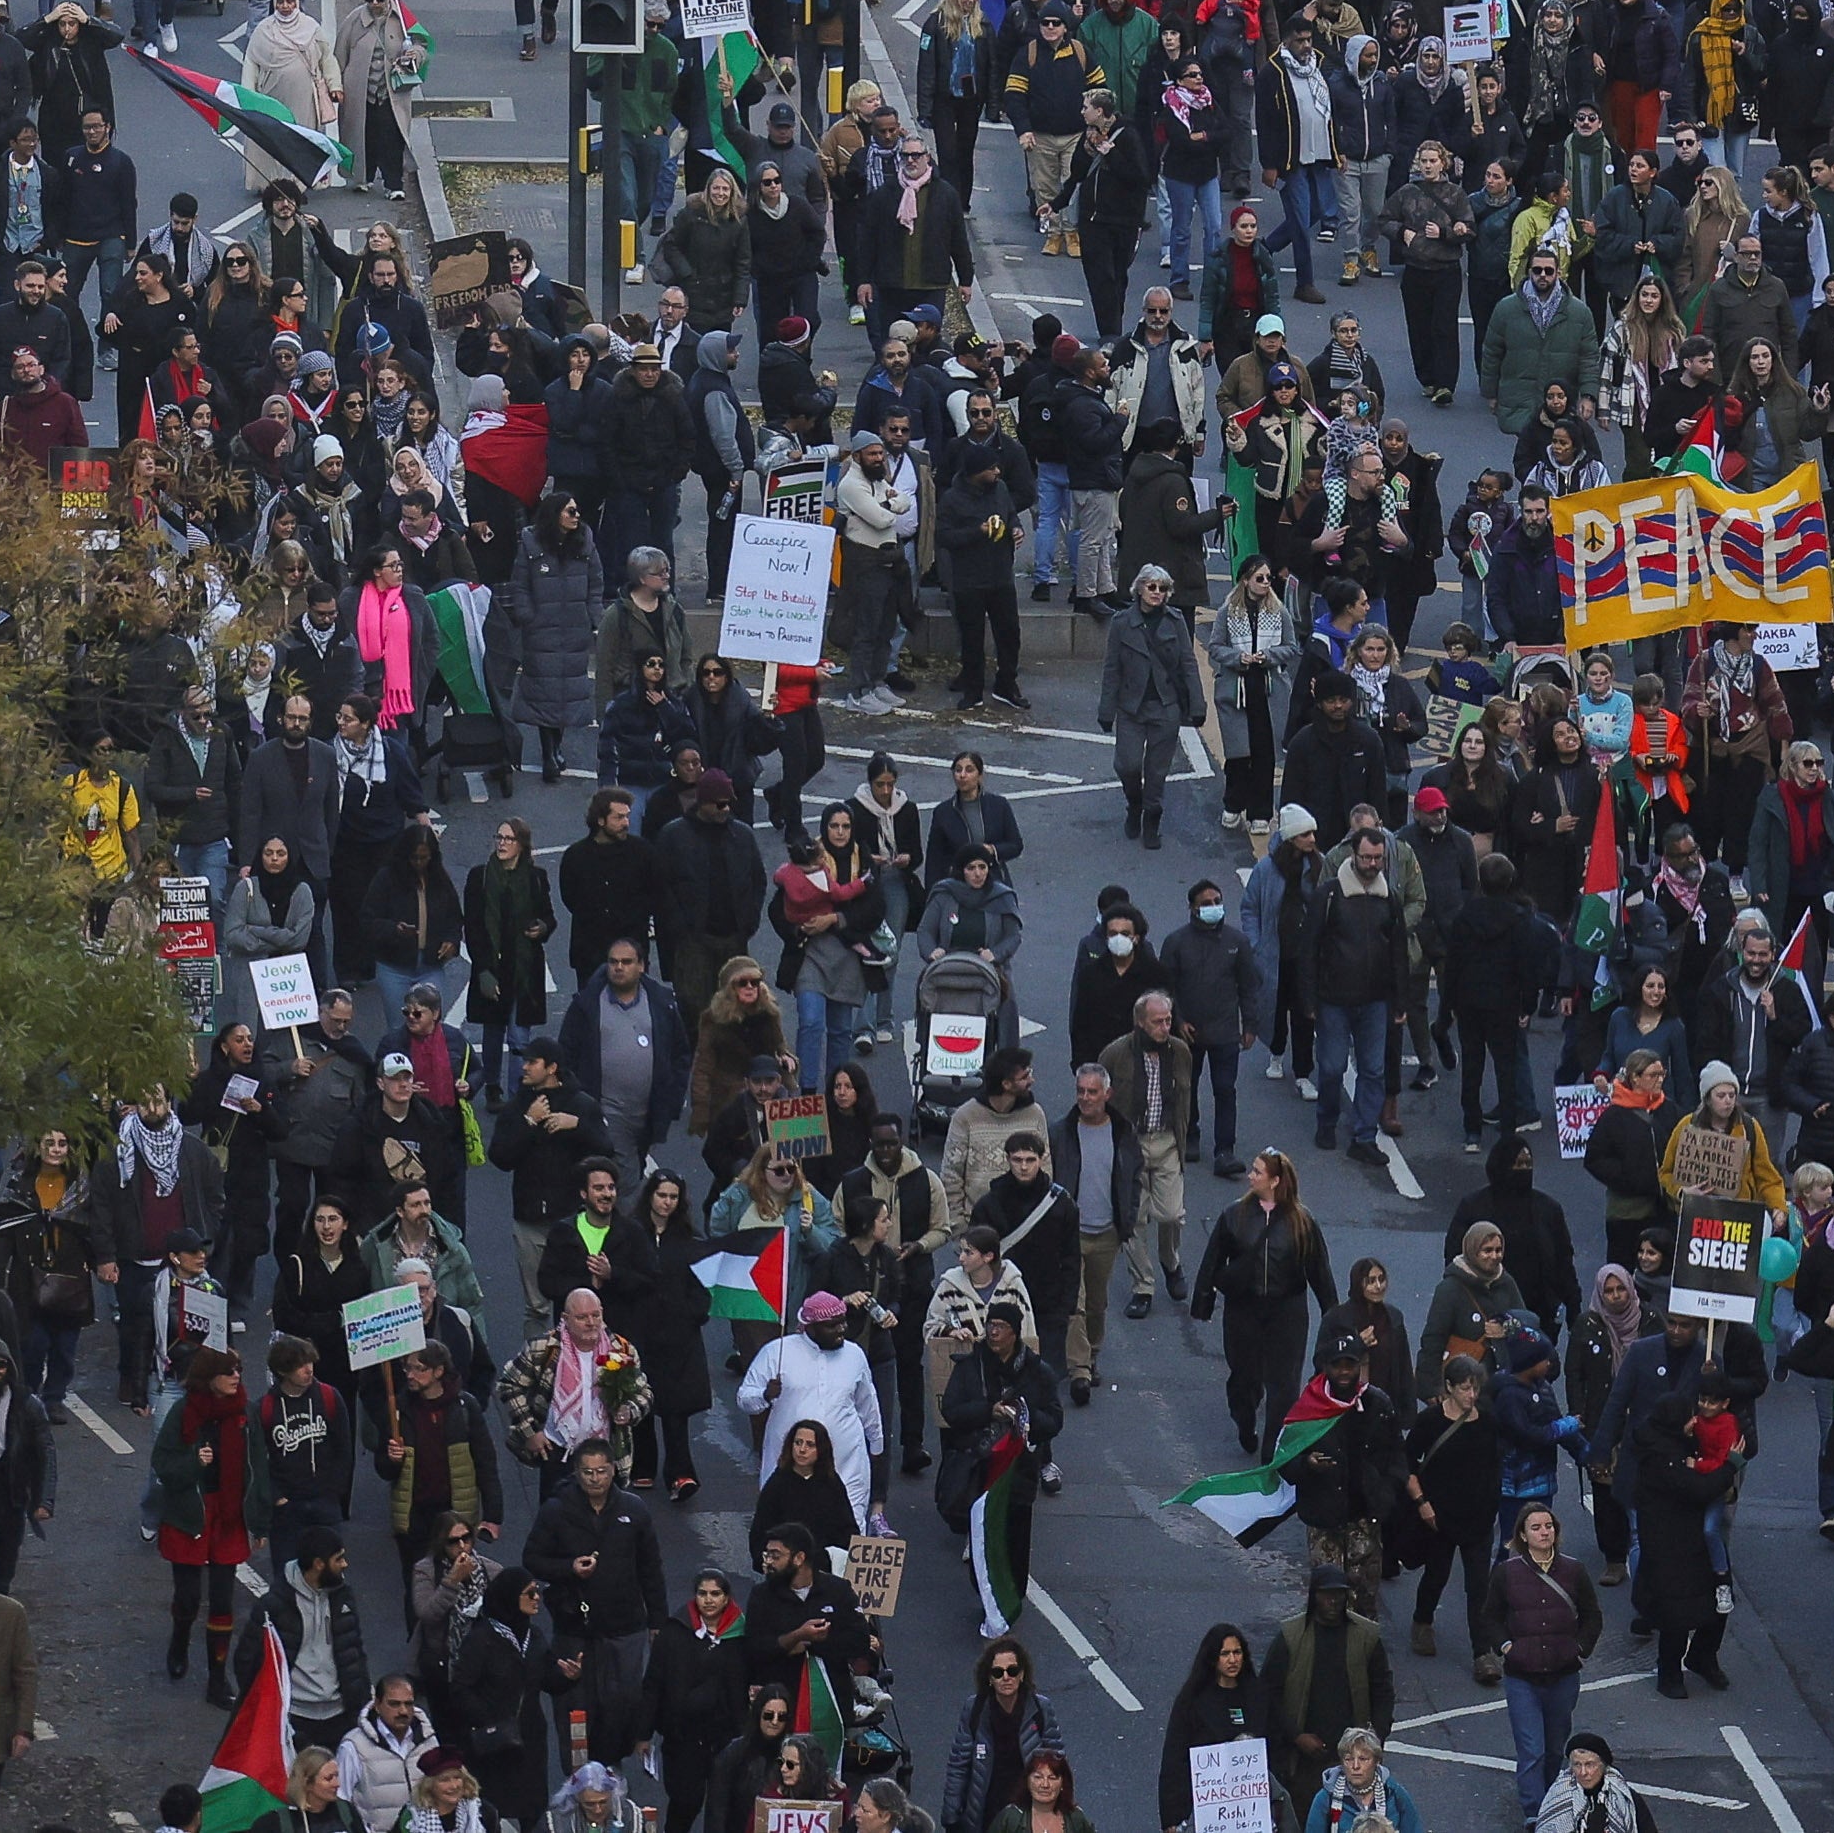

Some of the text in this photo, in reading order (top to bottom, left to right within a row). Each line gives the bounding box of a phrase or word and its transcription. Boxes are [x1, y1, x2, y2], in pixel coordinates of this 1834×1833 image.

[684, 2, 745, 20] PALESTINE
[434, 287, 486, 311] FREEDOM
[62, 460, 109, 492] END
[766, 492, 823, 520] FREE
[743, 523, 808, 553] Ceasefire
[1571, 487, 1809, 627] PEACE
[735, 585, 817, 614] Stop the Brutality
[729, 605, 775, 619] Stop the
[1756, 629, 1797, 641] NAKBA
[1762, 644, 1791, 656] 2023
[161, 907, 210, 922] PALESTINE
[260, 963, 302, 979] Jews
[270, 978, 297, 996] say
[263, 993, 312, 1008] ceasefire
[276, 1009, 308, 1021] now
[393, 1055, 406, 1065] W
[768, 1097, 824, 1120] CEASE
[775, 1136, 827, 1160] NOW!
[1680, 1144, 1734, 1167] IS A MORAL
[1676, 1171, 1737, 1191] FOR WORLD
[1717, 1166, 1739, 1181] TEST
[1692, 1218, 1751, 1248] END THE
[1688, 1238, 1748, 1272] SIEGE
[1338, 1340, 1348, 1352] P
[272, 1413, 328, 1449] Originals
[849, 1543, 905, 1568] CEASE
[854, 1568, 889, 1589] FIRE
[1196, 1752, 1259, 1772] UN says
[1195, 1774, 1241, 1790] Israel is
[1196, 1779, 1269, 1804] WAR CRIMES
[1217, 1803, 1248, 1821] Rishi
[770, 1812, 827, 1833] JEWS
[1203, 1820, 1263, 1833] stop being
